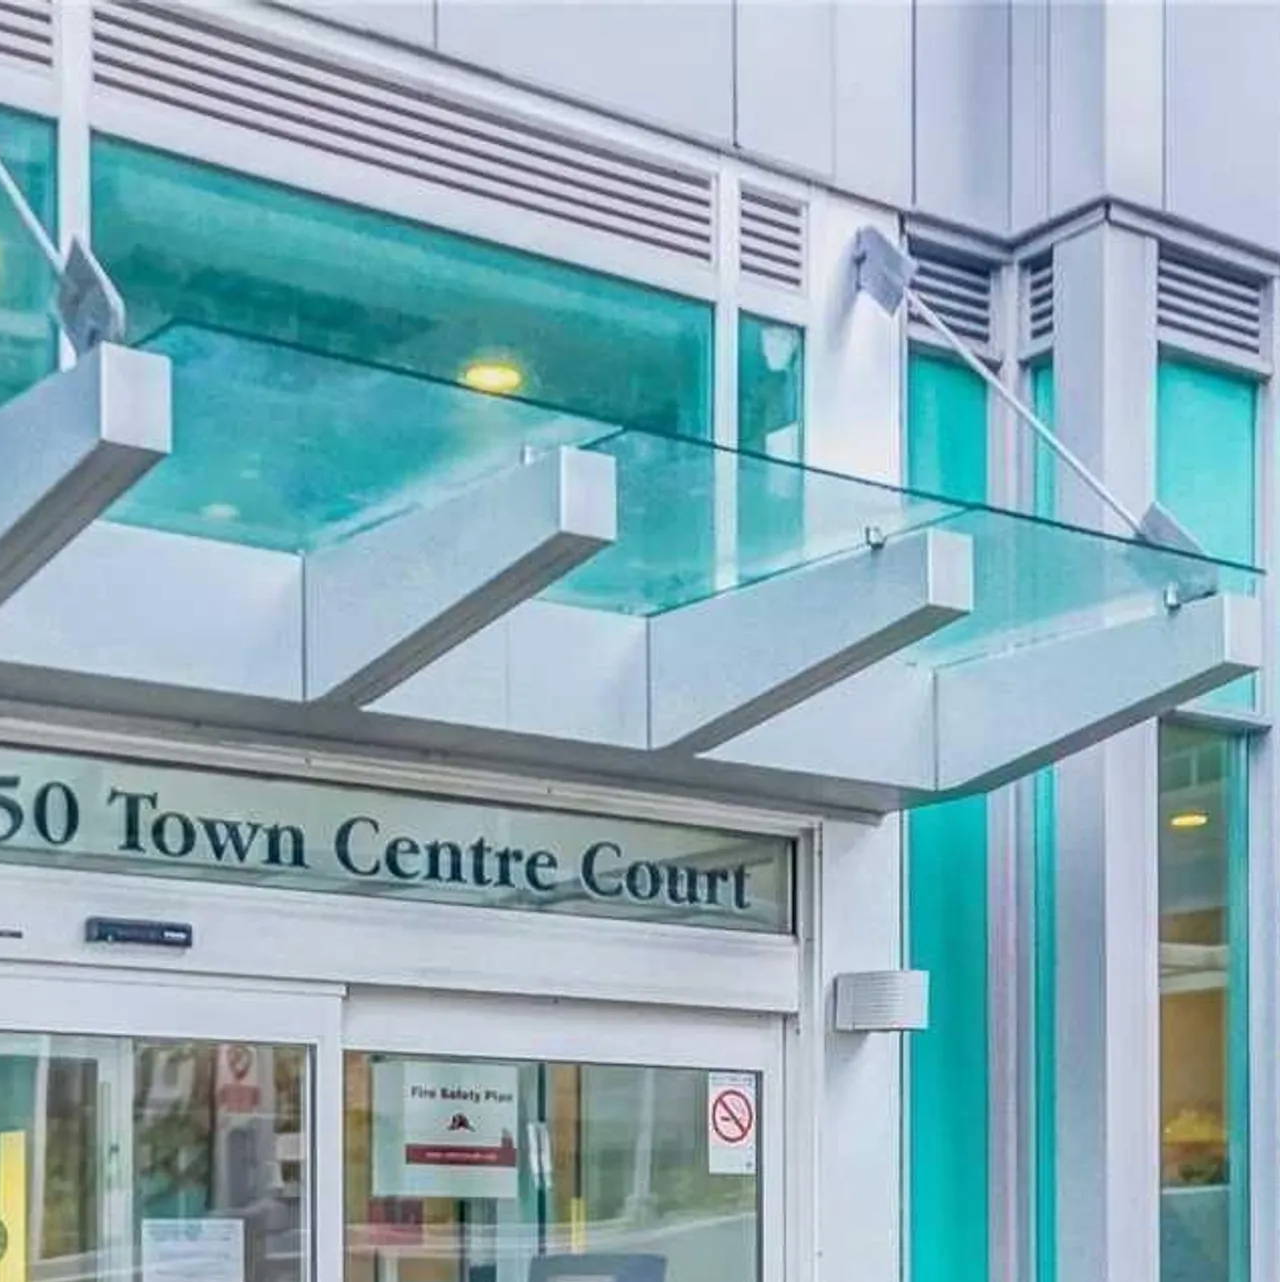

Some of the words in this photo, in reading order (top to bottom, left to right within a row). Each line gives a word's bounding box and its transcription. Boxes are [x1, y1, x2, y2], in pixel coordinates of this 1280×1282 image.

[107, 786, 310, 869] Town
[333, 815, 559, 892] Centre
[581, 841, 752, 910] Court
[410, 1084, 437, 1100] Fire
[440, 1086, 480, 1104] Safety
